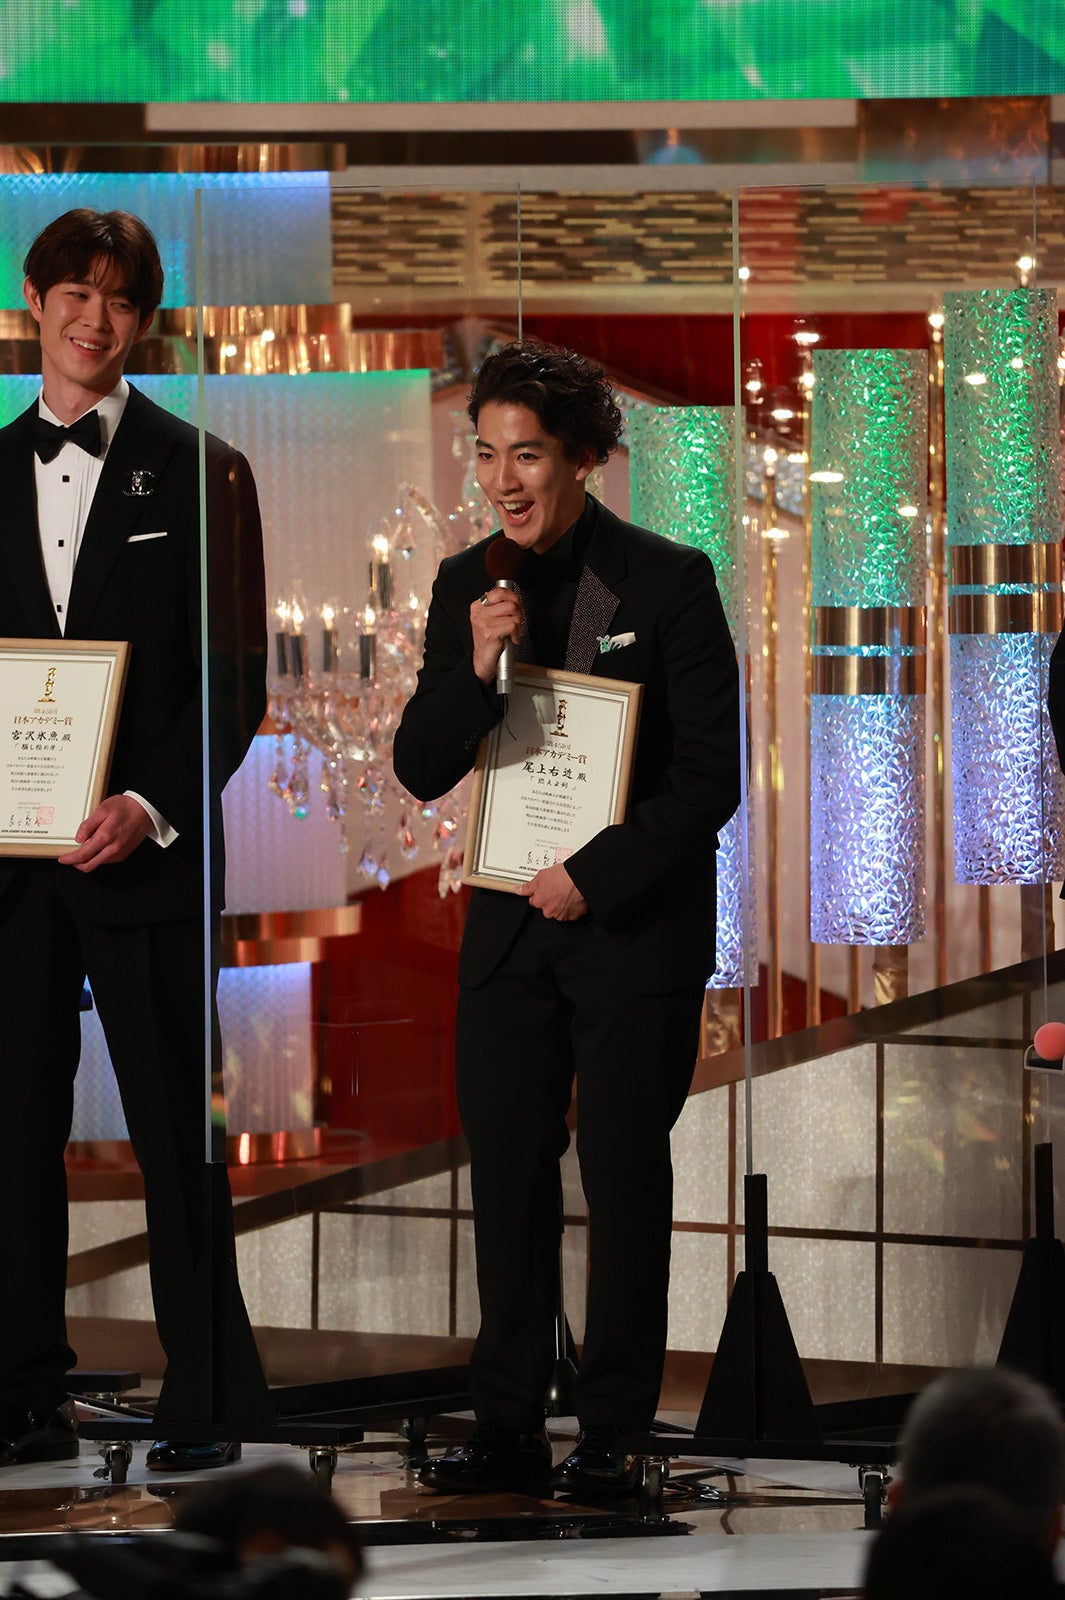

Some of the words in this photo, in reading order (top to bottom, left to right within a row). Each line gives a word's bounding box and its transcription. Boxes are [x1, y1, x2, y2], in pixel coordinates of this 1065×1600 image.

[14, 716, 73, 726] 日本アカデミー賞
[526, 746, 587, 764] 日本アカデミー賞
